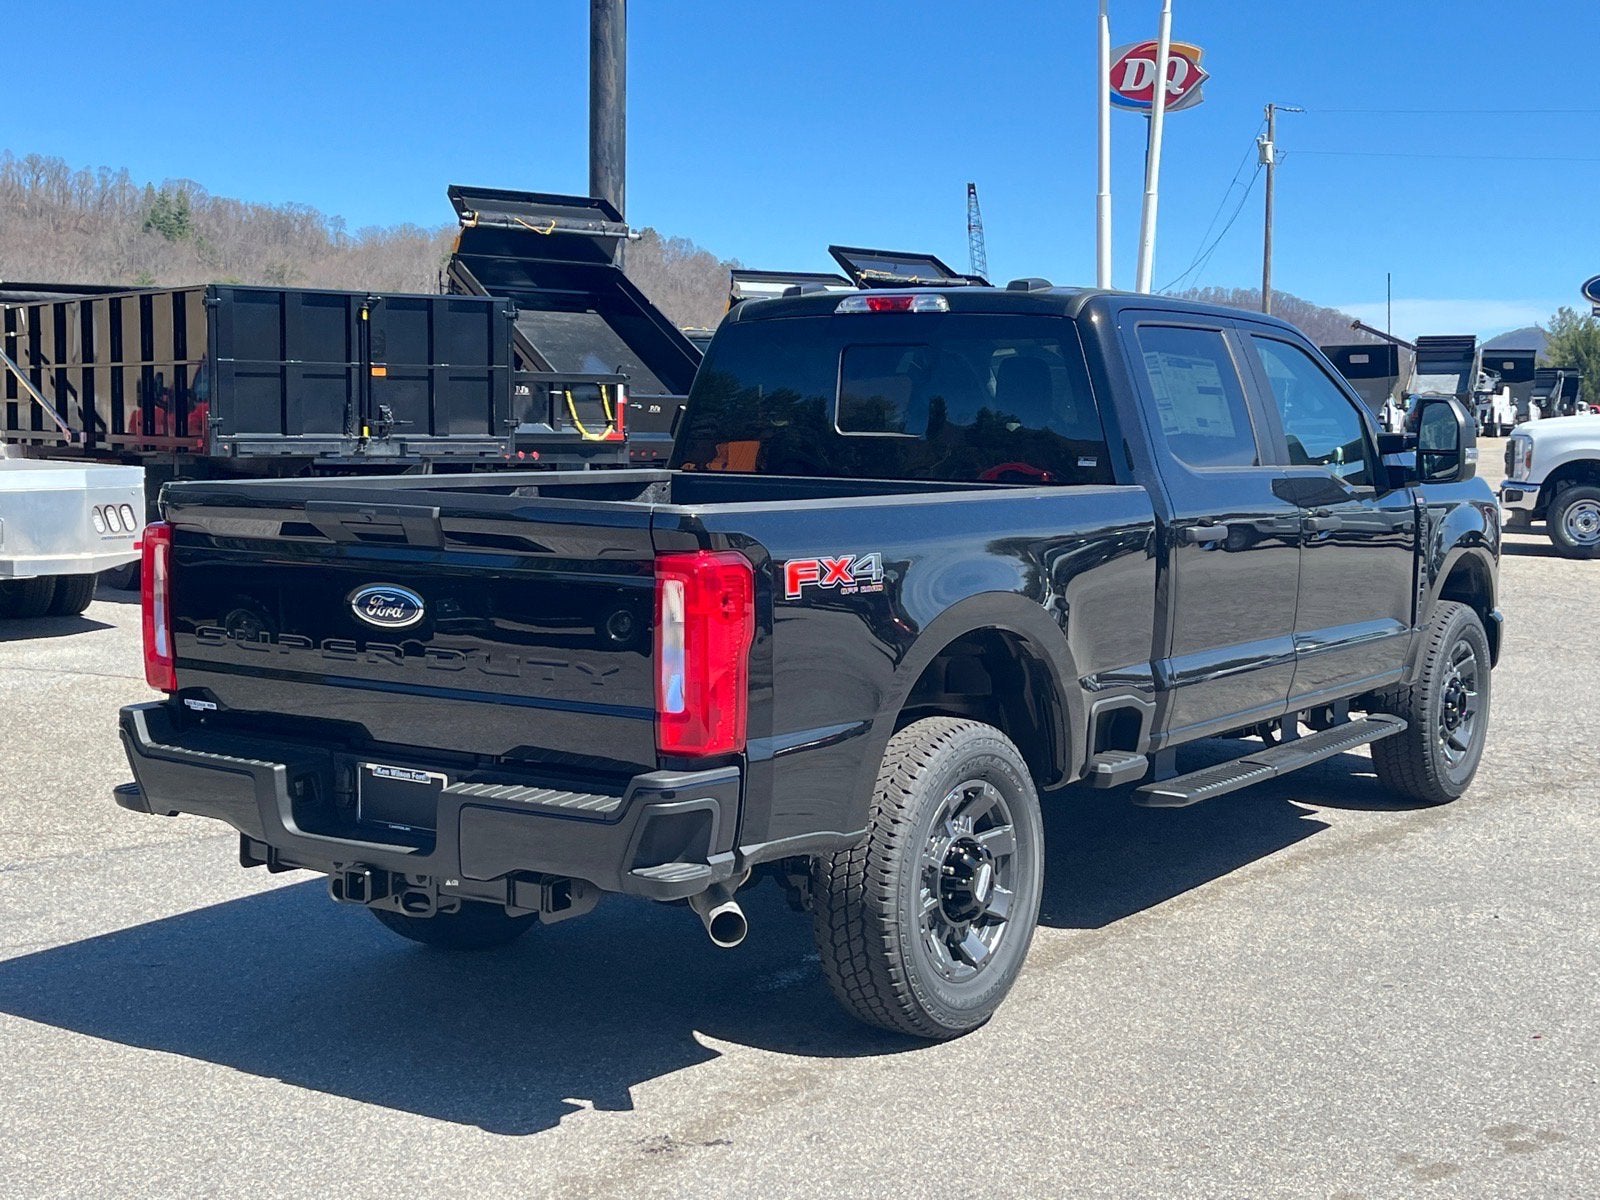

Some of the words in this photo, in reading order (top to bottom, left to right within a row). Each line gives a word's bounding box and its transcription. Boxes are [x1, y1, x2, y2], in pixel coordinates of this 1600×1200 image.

[1119, 56, 1189, 95] DQ
[784, 552, 884, 600] FX4
[366, 594, 405, 619] Ford
[195, 625, 405, 667] SUPER
[423, 646, 621, 687] DUTY
[376, 766, 390, 776] Ken
[390, 769, 411, 779] Wilson
[412, 772, 427, 781] Ford
